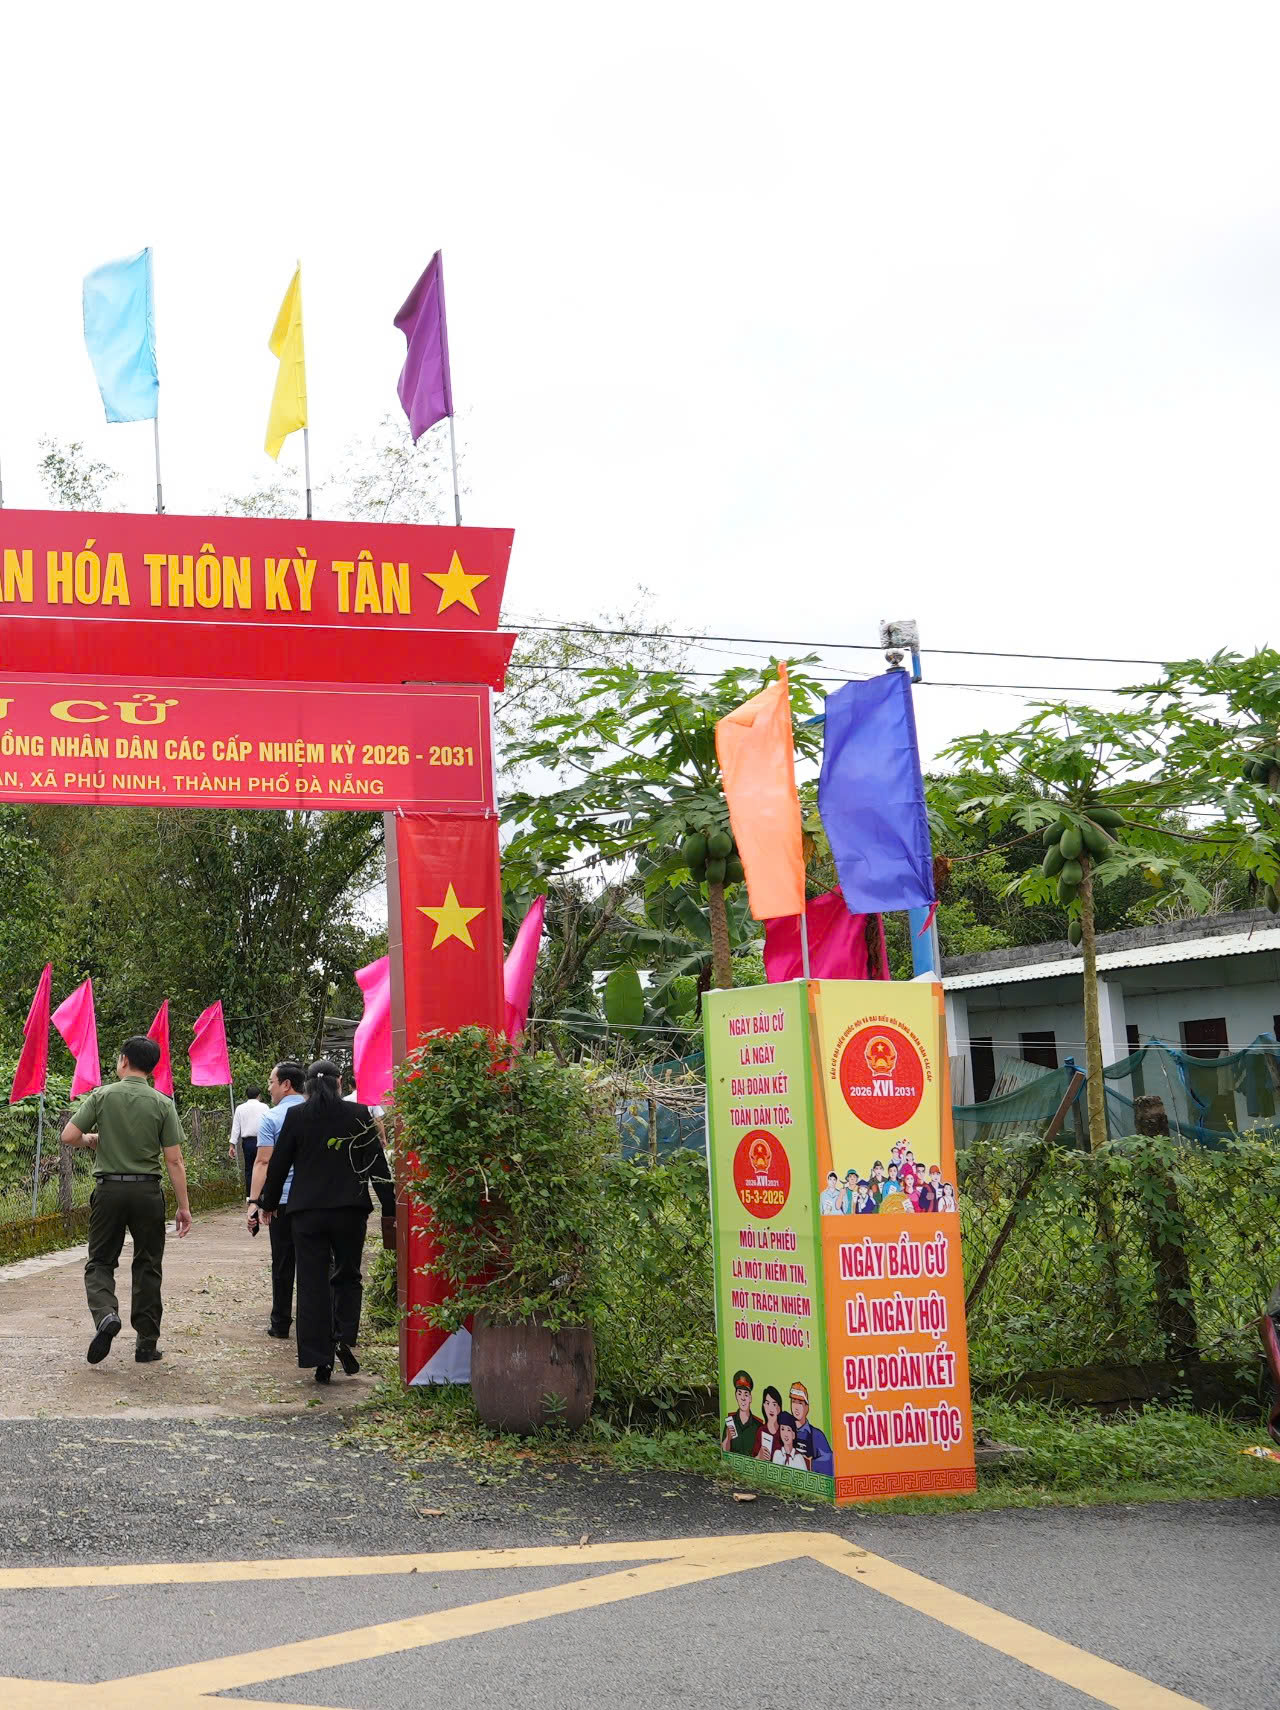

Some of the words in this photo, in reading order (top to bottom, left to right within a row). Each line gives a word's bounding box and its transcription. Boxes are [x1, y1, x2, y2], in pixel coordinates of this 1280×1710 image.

[47, 538, 130, 606] HÓA
[143, 543, 252, 609] THÔN
[265, 546, 317, 612] KỲ
[332, 550, 411, 615] TÂN
[50, 693, 179, 725] CỬ
[51, 733, 109, 758] NHÂN
[116, 735, 158, 760] DÂN
[164, 736, 206, 761] CÁC
[212, 734, 253, 762] CẤP
[259, 739, 324, 767] NHIỆM
[331, 739, 356, 765] KỲ
[362, 745, 410, 765] 2026
[429, 746, 474, 766] 2031
[30, 768, 58, 788] XÃ
[64, 769, 105, 789] PHÚ
[112, 774, 167, 793] NINH,
[173, 771, 241, 792] THÀNH
[248, 771, 289, 793] PHỐ
[295, 775, 320, 794] ĐÀ
[328, 772, 384, 795] NẴNG
[729, 1014, 750, 1036] NGÀY
[753, 1010, 770, 1034] BẦU
[772, 1008, 784, 1031] CỬ
[740, 1045, 751, 1065] LÀ
[752, 1044, 775, 1064] NGÀY
[731, 1079, 745, 1100] ĐẠI
[747, 1074, 770, 1096] ĐOÀN
[772, 1071, 788, 1094] KẾT
[850, 1086, 872, 1097] 2026
[872, 1080, 894, 1097] XVI
[895, 1086, 916, 1097] 2031
[730, 1106, 752, 1126] TOÀN
[753, 1105, 771, 1125] DÂN
[772, 1103, 793, 1129] TỘC.
[756, 1176, 767, 1187] XVI
[740, 1189, 785, 1205] 15-3-2026
[739, 1225, 756, 1249] MỖI
[758, 1226, 768, 1250] LÁ
[770, 1227, 797, 1252] PHIẾU
[841, 1238, 883, 1278] NGÀY
[888, 1232, 920, 1277] BẦU
[924, 1234, 946, 1275] CỬ
[732, 1258, 743, 1278] LÀ
[744, 1260, 762, 1283] MỘT
[765, 1257, 787, 1283] NIỀM
[790, 1264, 807, 1286] TIN,
[731, 1288, 749, 1312] MỘT
[751, 1288, 779, 1313] TRÁCH
[781, 1293, 811, 1319] NHIỆM
[848, 1293, 868, 1333] LÀ
[873, 1294, 913, 1332] NGÀY
[920, 1291, 946, 1336] HỘI
[735, 1316, 749, 1340] ĐỐI
[750, 1319, 765, 1342] VỚI
[767, 1319, 778, 1344] TỔ
[780, 1320, 804, 1348] QUỐC
[845, 1358, 872, 1397] ĐẠI
[878, 1348, 921, 1387] ĐOÀN
[926, 1343, 954, 1386] KẾT
[845, 1408, 888, 1447] TOÀN
[893, 1406, 926, 1445] DÂN
[930, 1403, 960, 1449] TỘC
